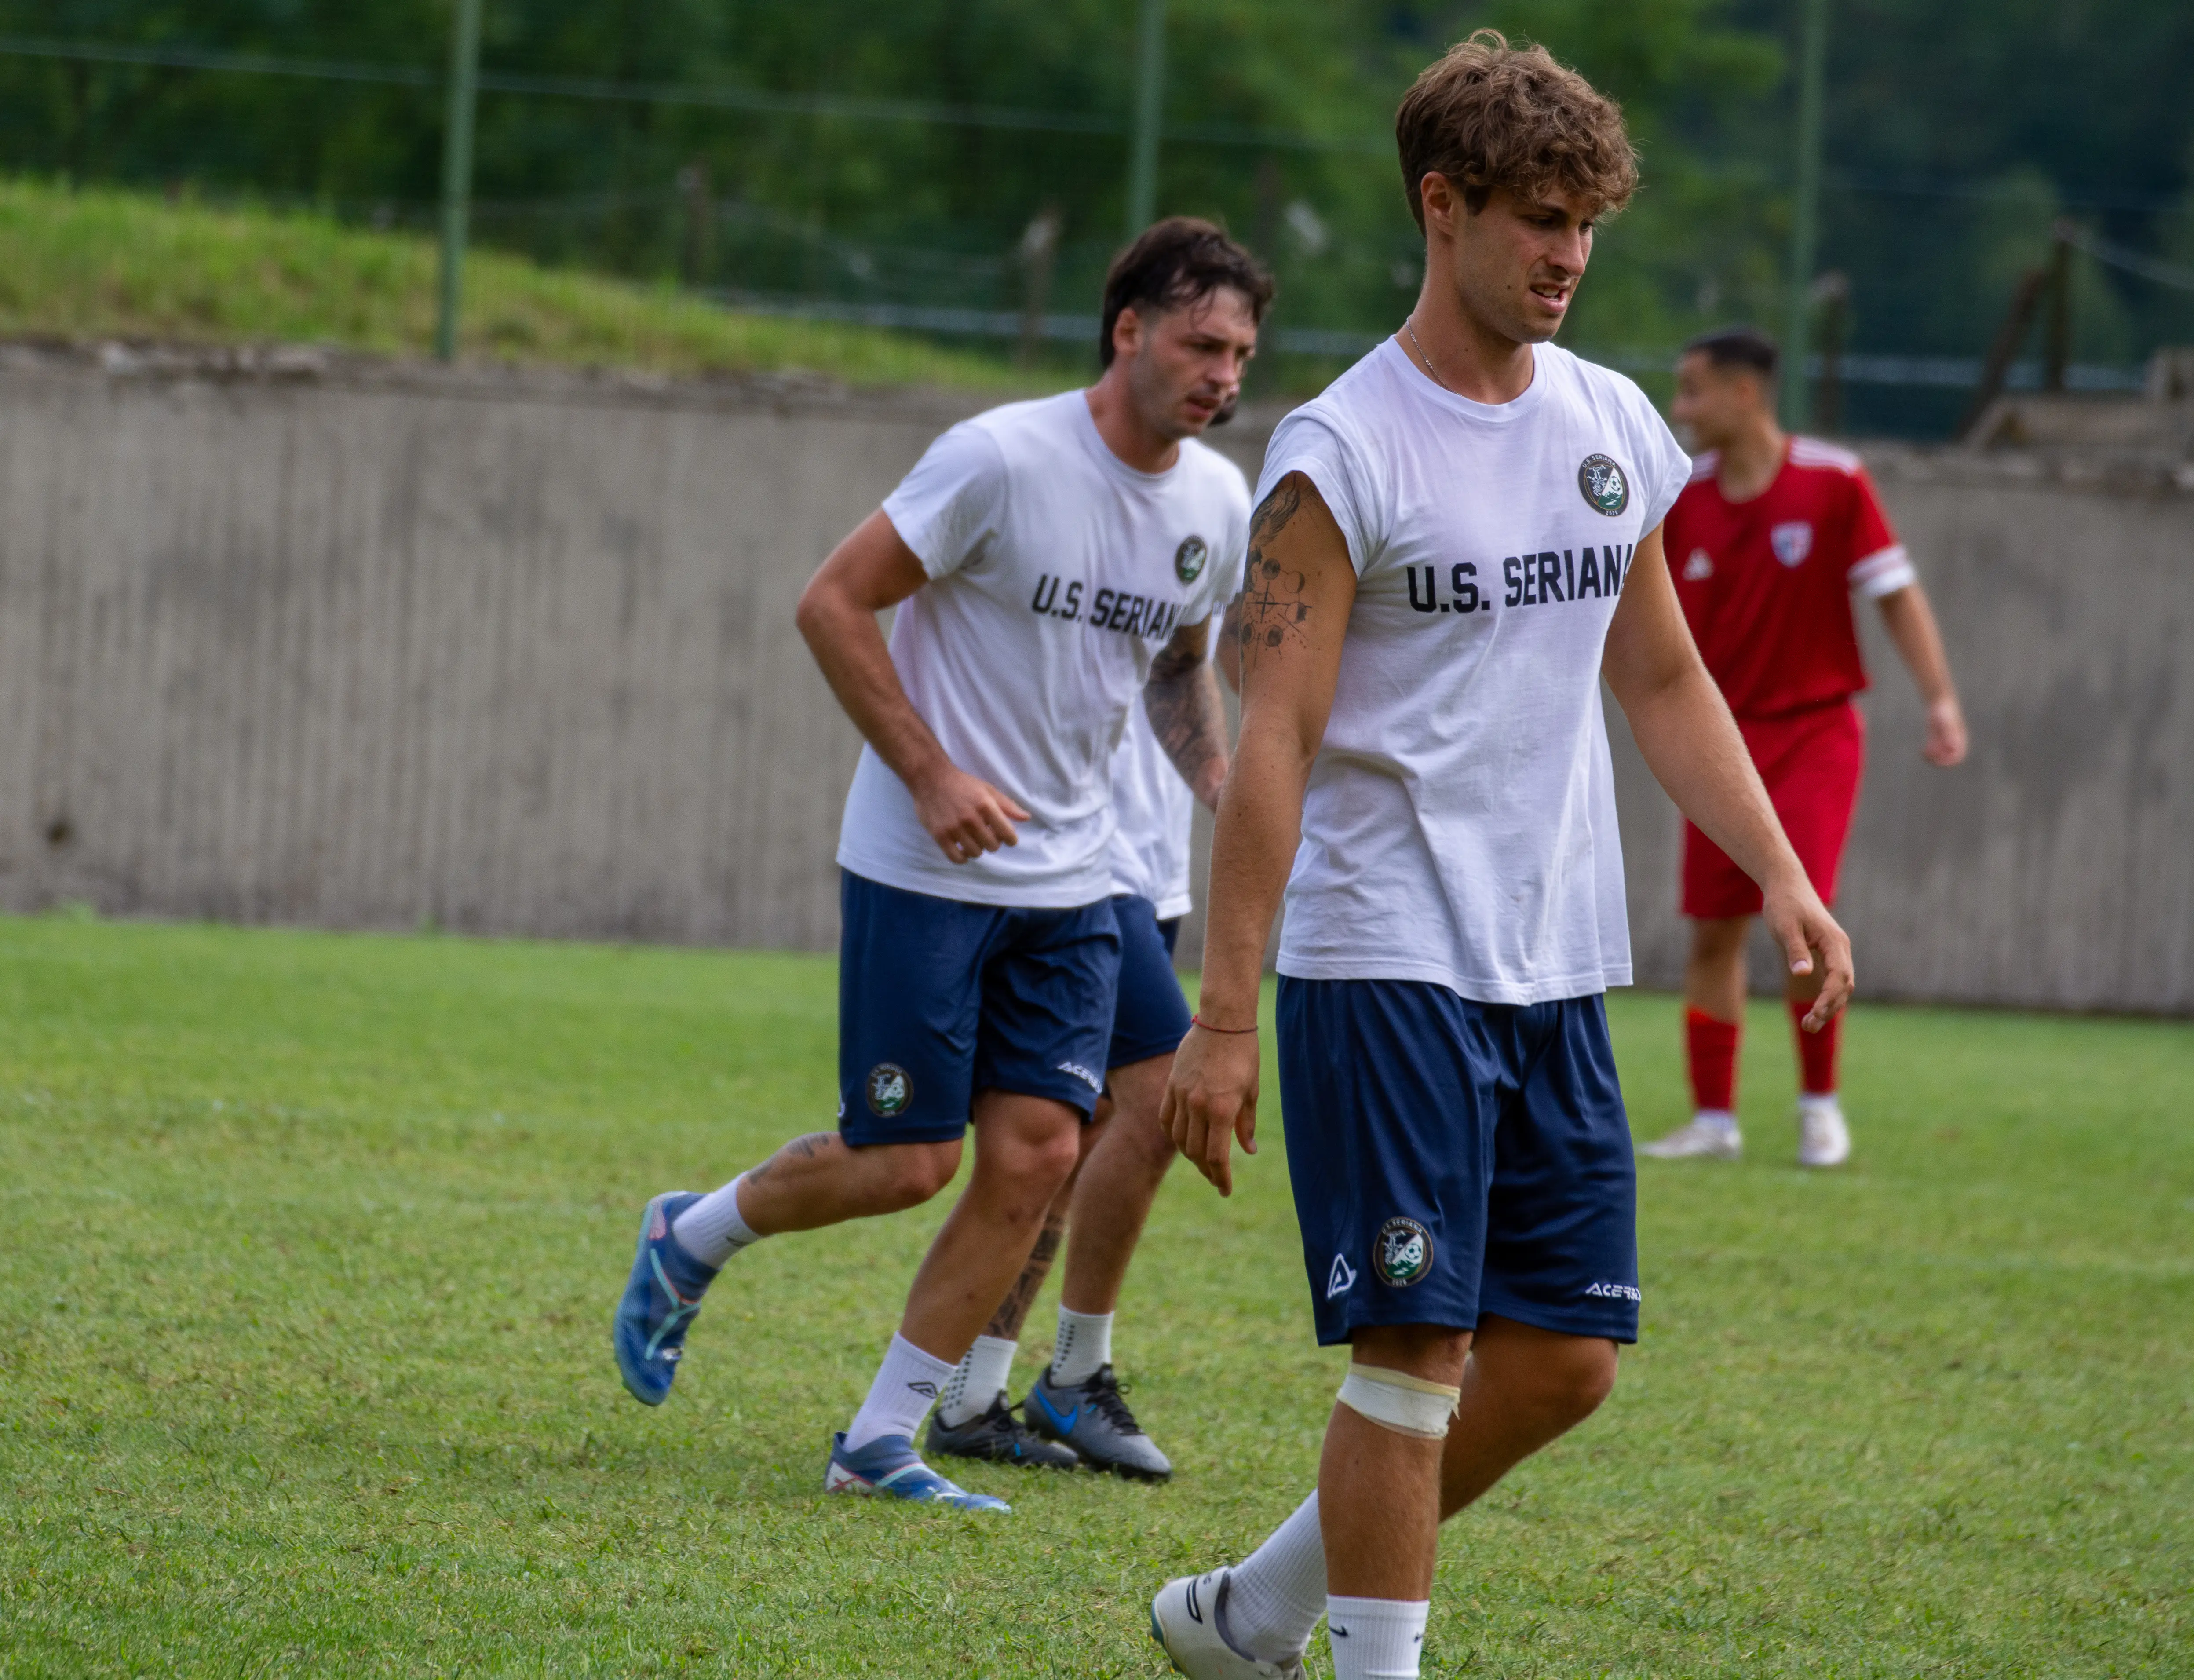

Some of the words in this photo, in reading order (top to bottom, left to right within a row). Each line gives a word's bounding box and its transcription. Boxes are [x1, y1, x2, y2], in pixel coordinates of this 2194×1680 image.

[1592, 454, 1616, 467] SERIANA
[1032, 573, 1083, 623] U.S.
[1407, 562, 1490, 614] U.S.
